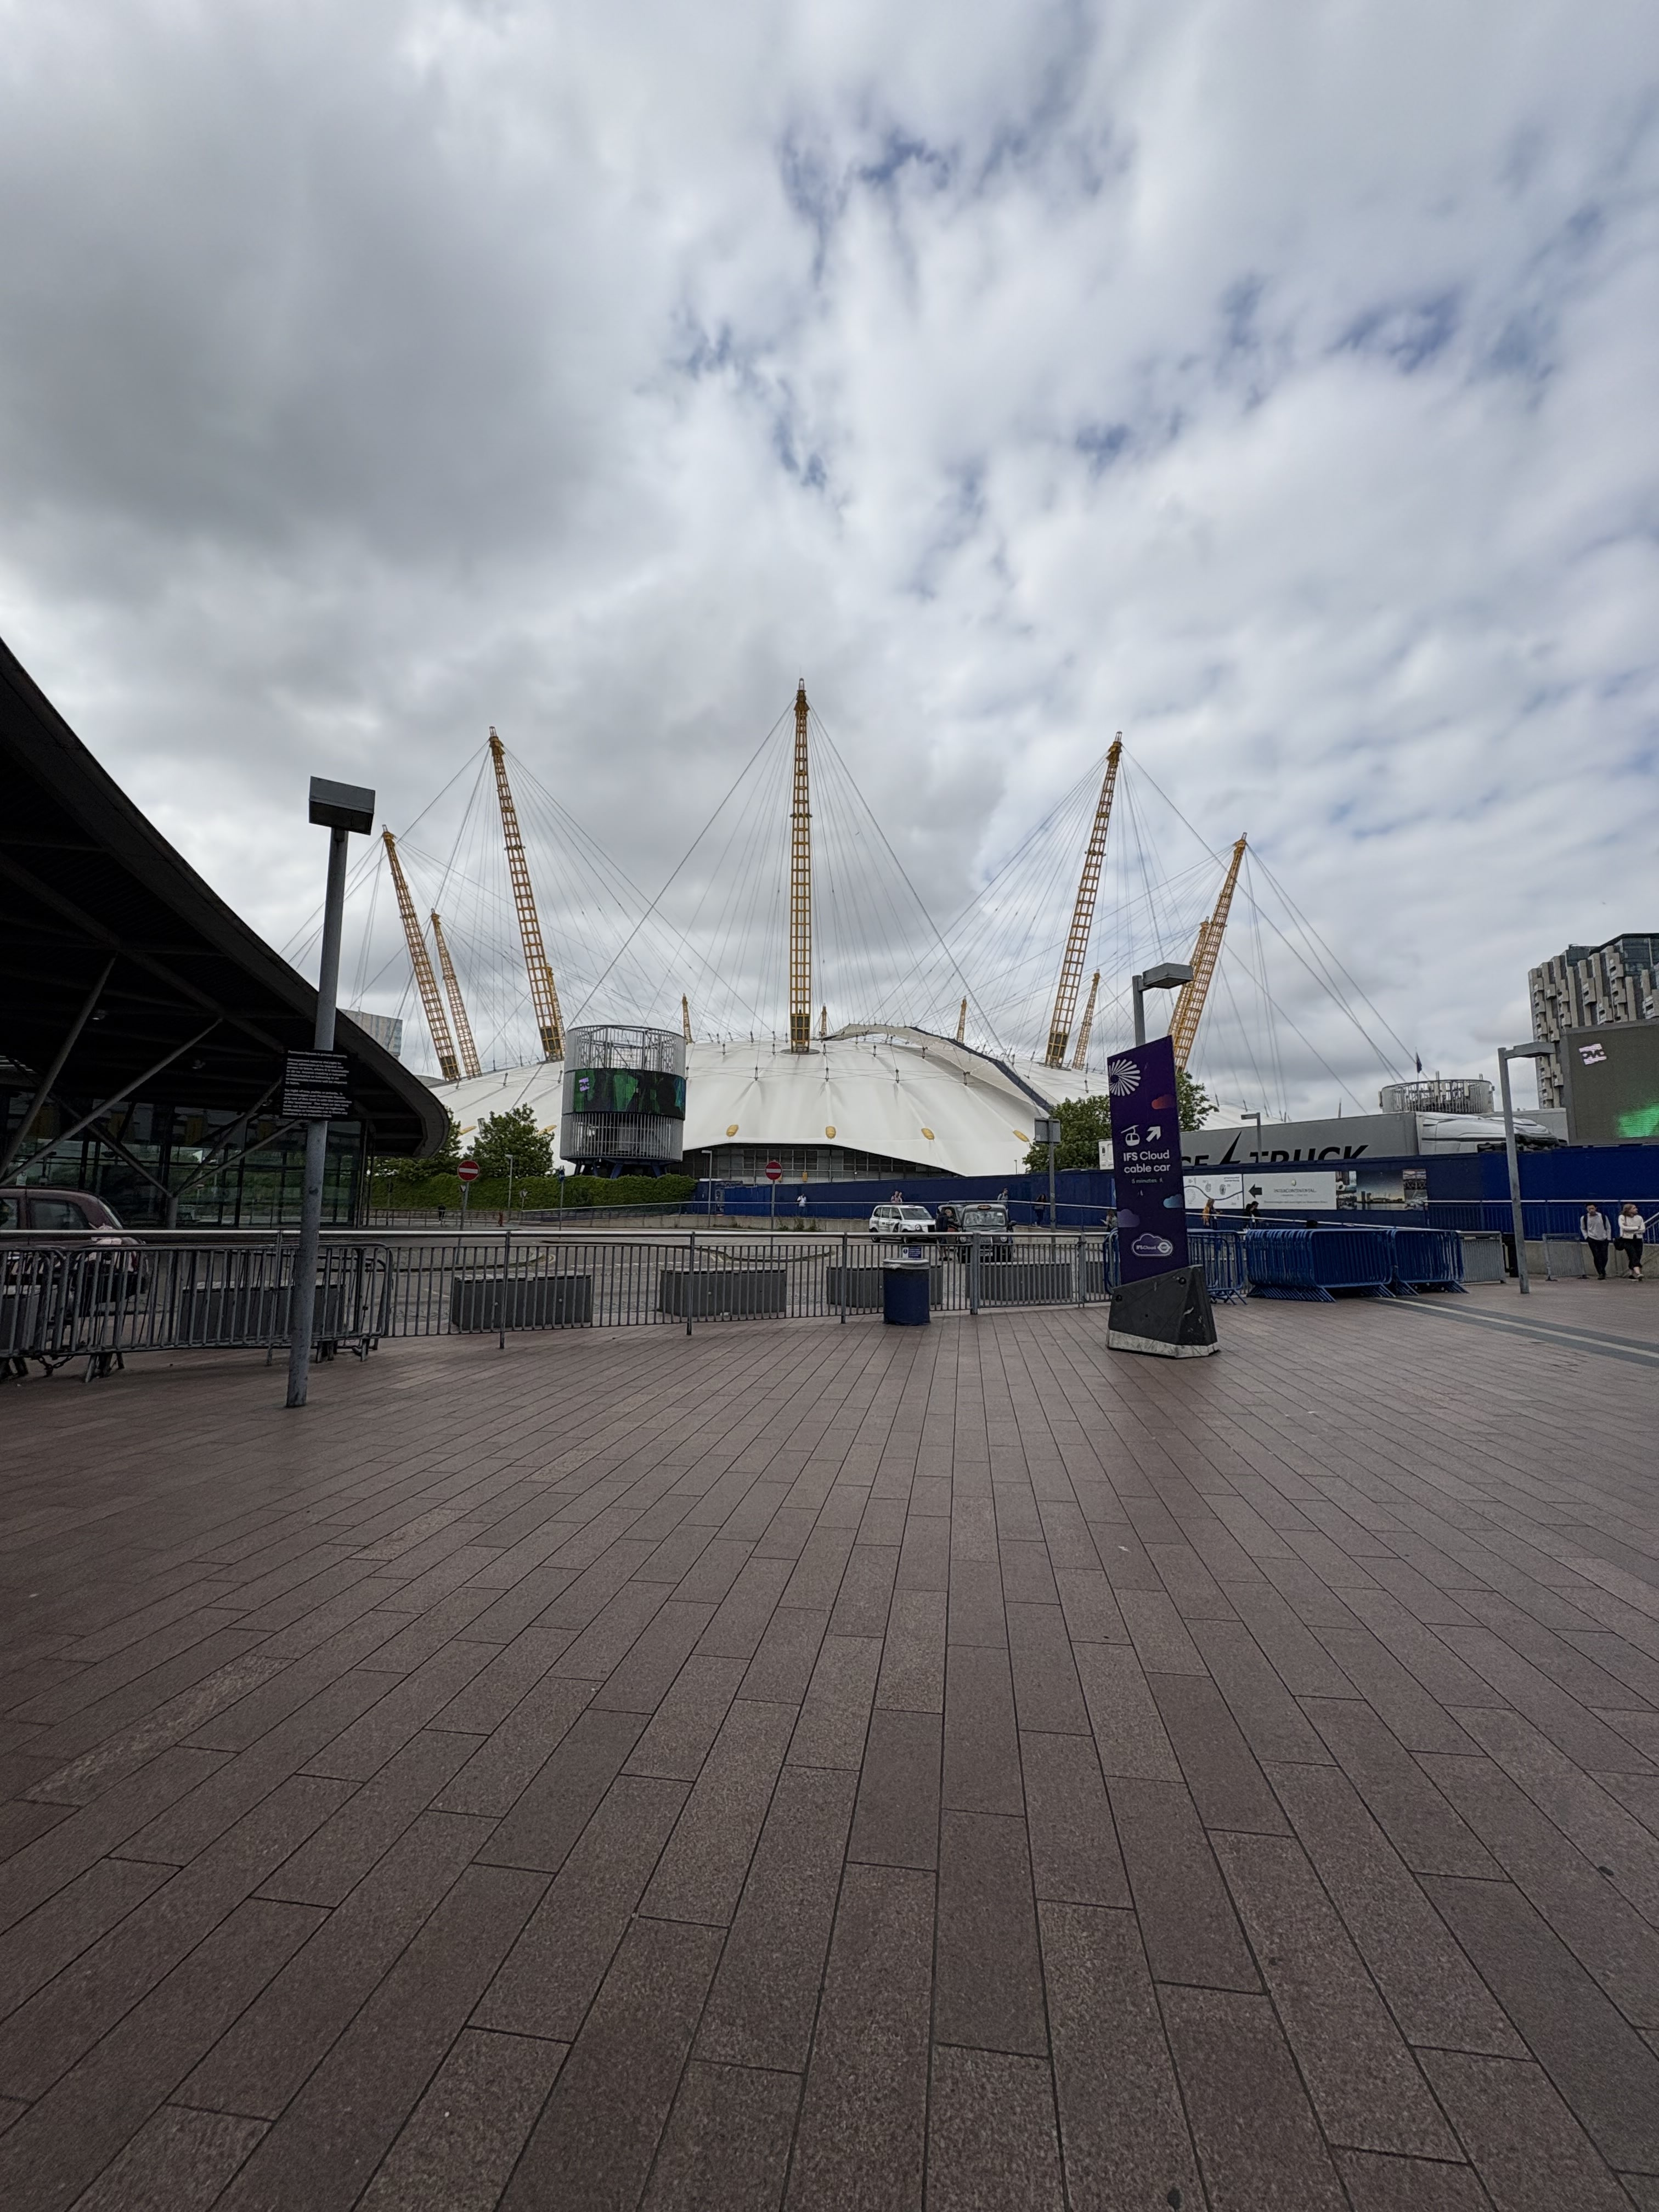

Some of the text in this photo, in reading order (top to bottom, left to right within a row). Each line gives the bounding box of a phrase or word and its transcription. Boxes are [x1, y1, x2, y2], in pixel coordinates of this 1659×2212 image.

[1124, 1149, 1170, 1161] IFS Cloud
[1124, 1163, 1152, 1173] cable
